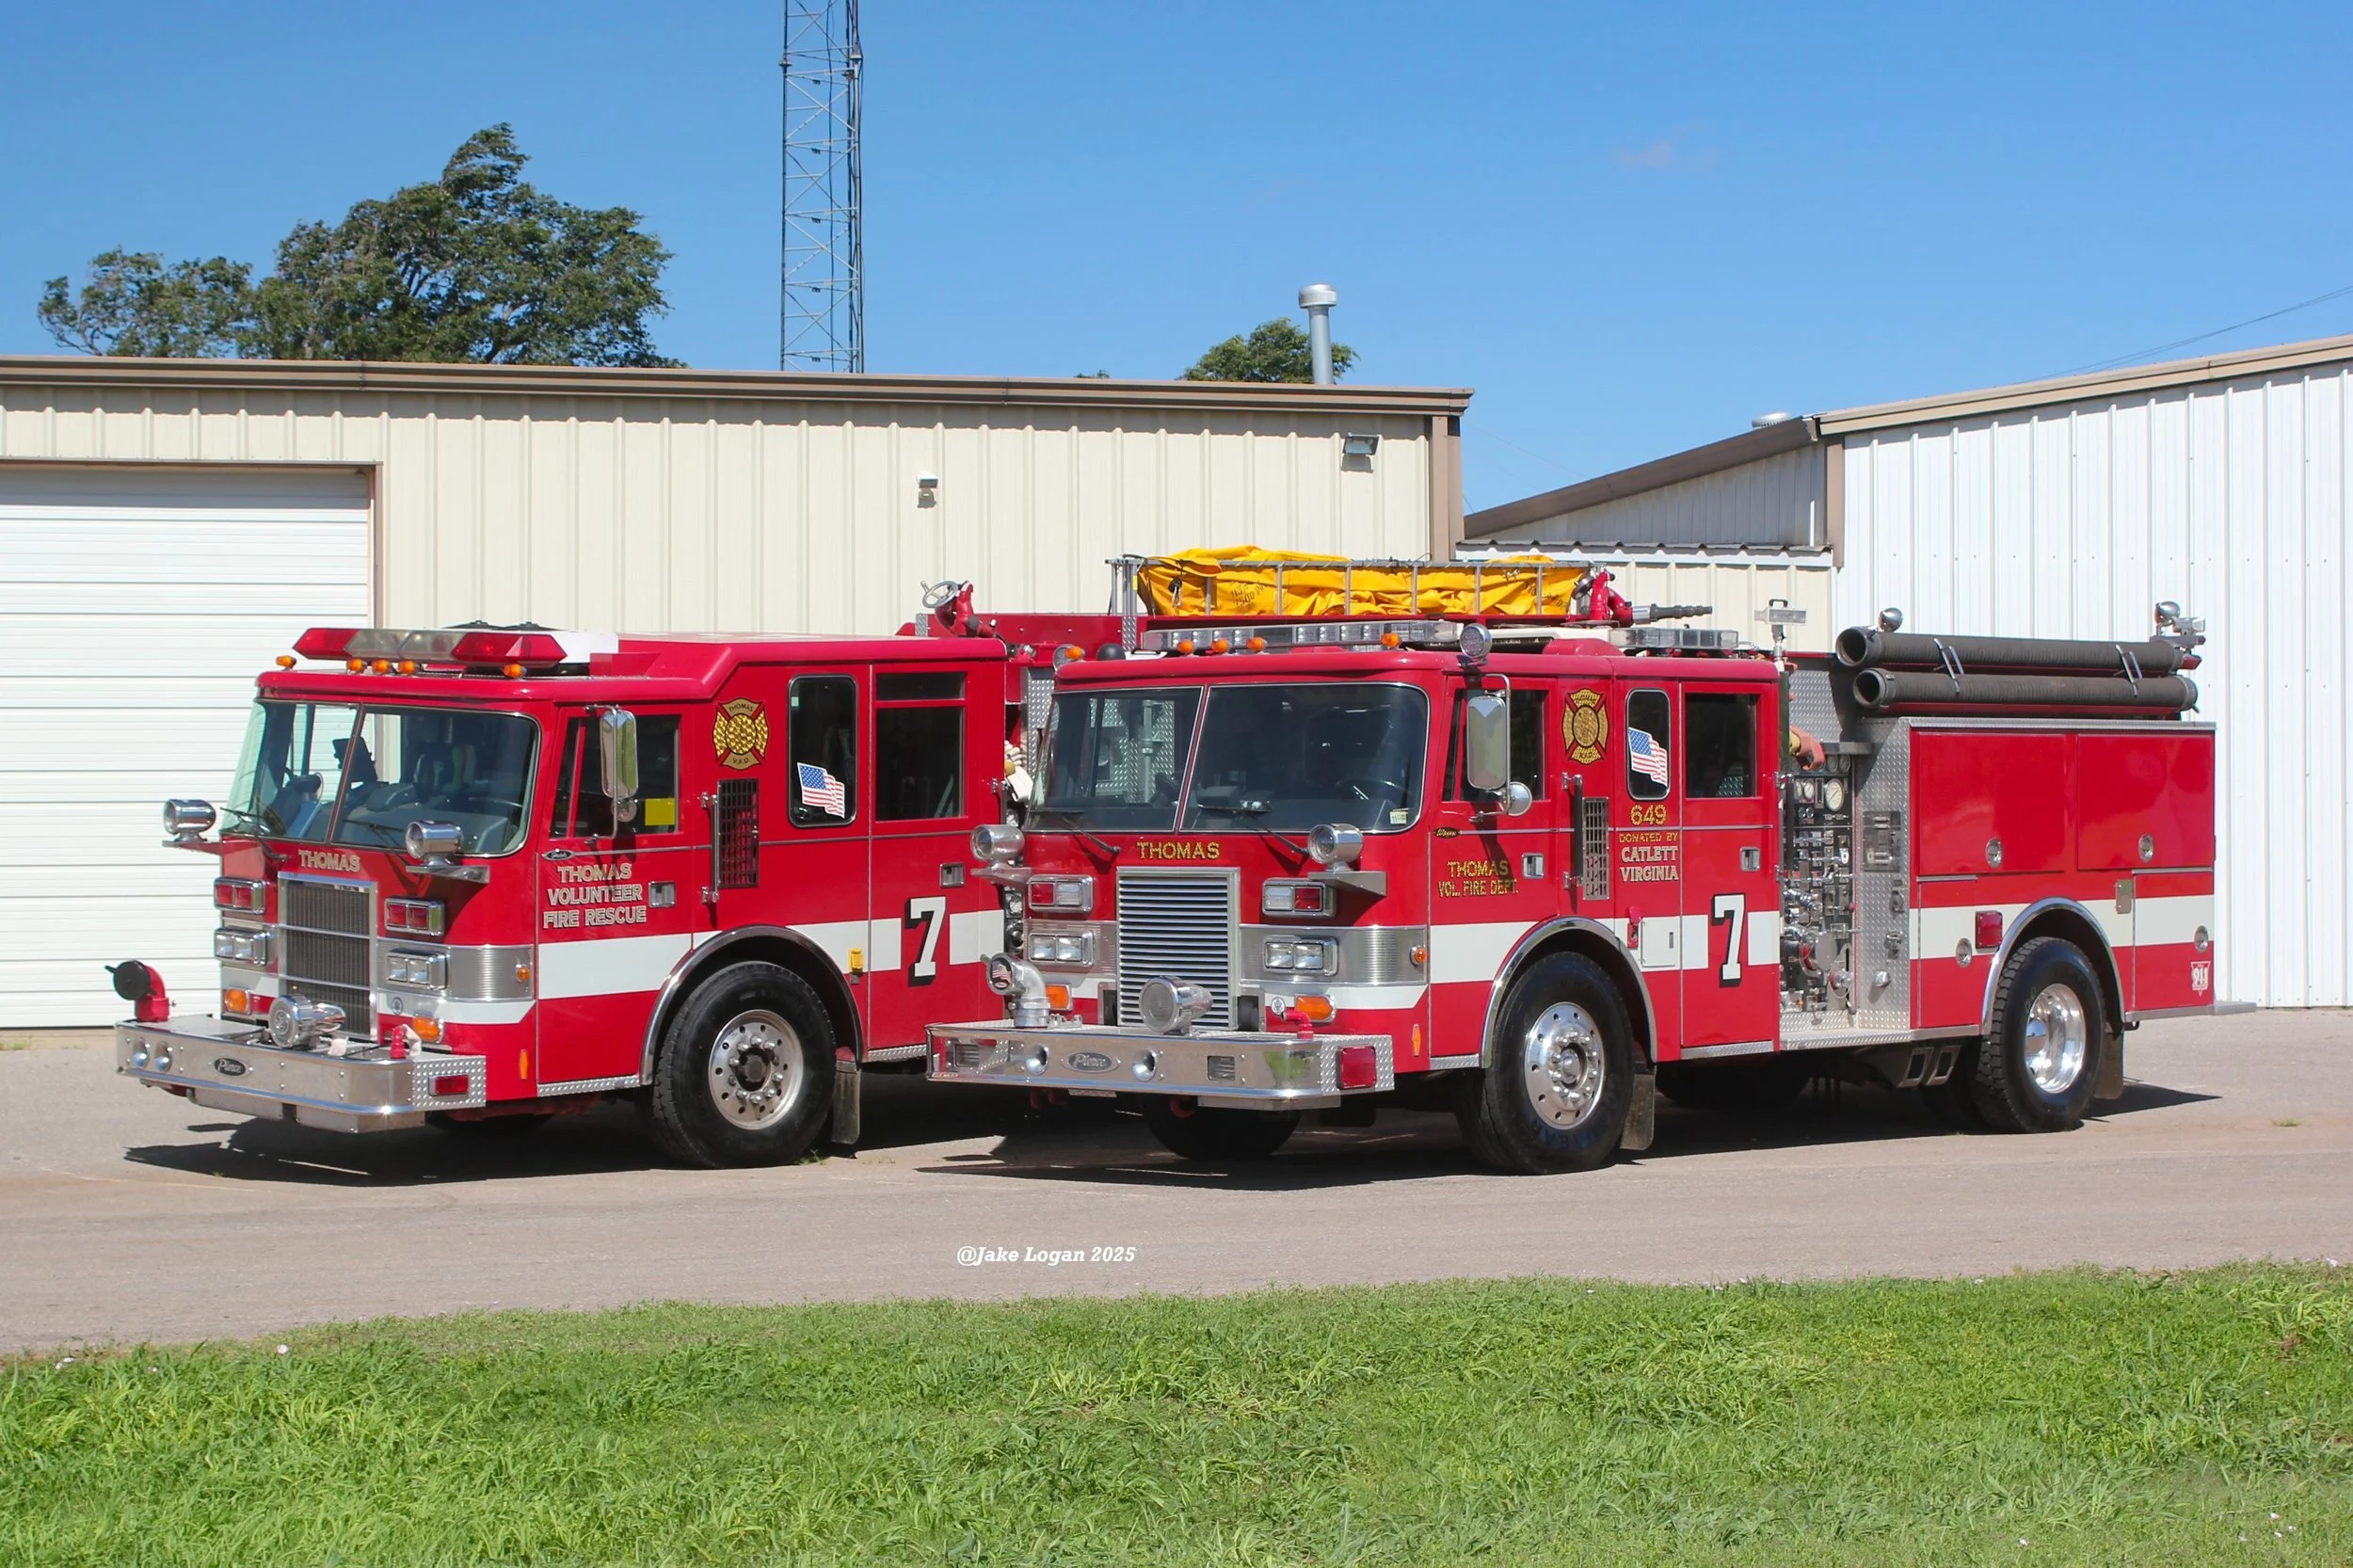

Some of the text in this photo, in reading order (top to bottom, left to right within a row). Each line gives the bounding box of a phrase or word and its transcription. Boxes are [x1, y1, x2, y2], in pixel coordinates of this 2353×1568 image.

[728, 703, 754, 712] THOMAS
[1630, 804, 1667, 825] 649
[1619, 831, 1678, 843] DONATED BY
[1136, 841, 1221, 860] THOMAS
[1621, 845, 1678, 863] CATLETT
[297, 849, 361, 873] THOMAS
[1447, 859, 1510, 878] THOMAS
[557, 862, 632, 884] THOMAS
[1619, 865, 1679, 883] VIRGINIA
[547, 883, 643, 906] VOLUNTEER
[1463, 879, 1487, 897] FIRE
[1489, 877, 1519, 896] DEPT.
[543, 904, 648, 929] FIRE RESCUE
[906, 895, 947, 984] 7
[1712, 893, 1745, 986] 7
